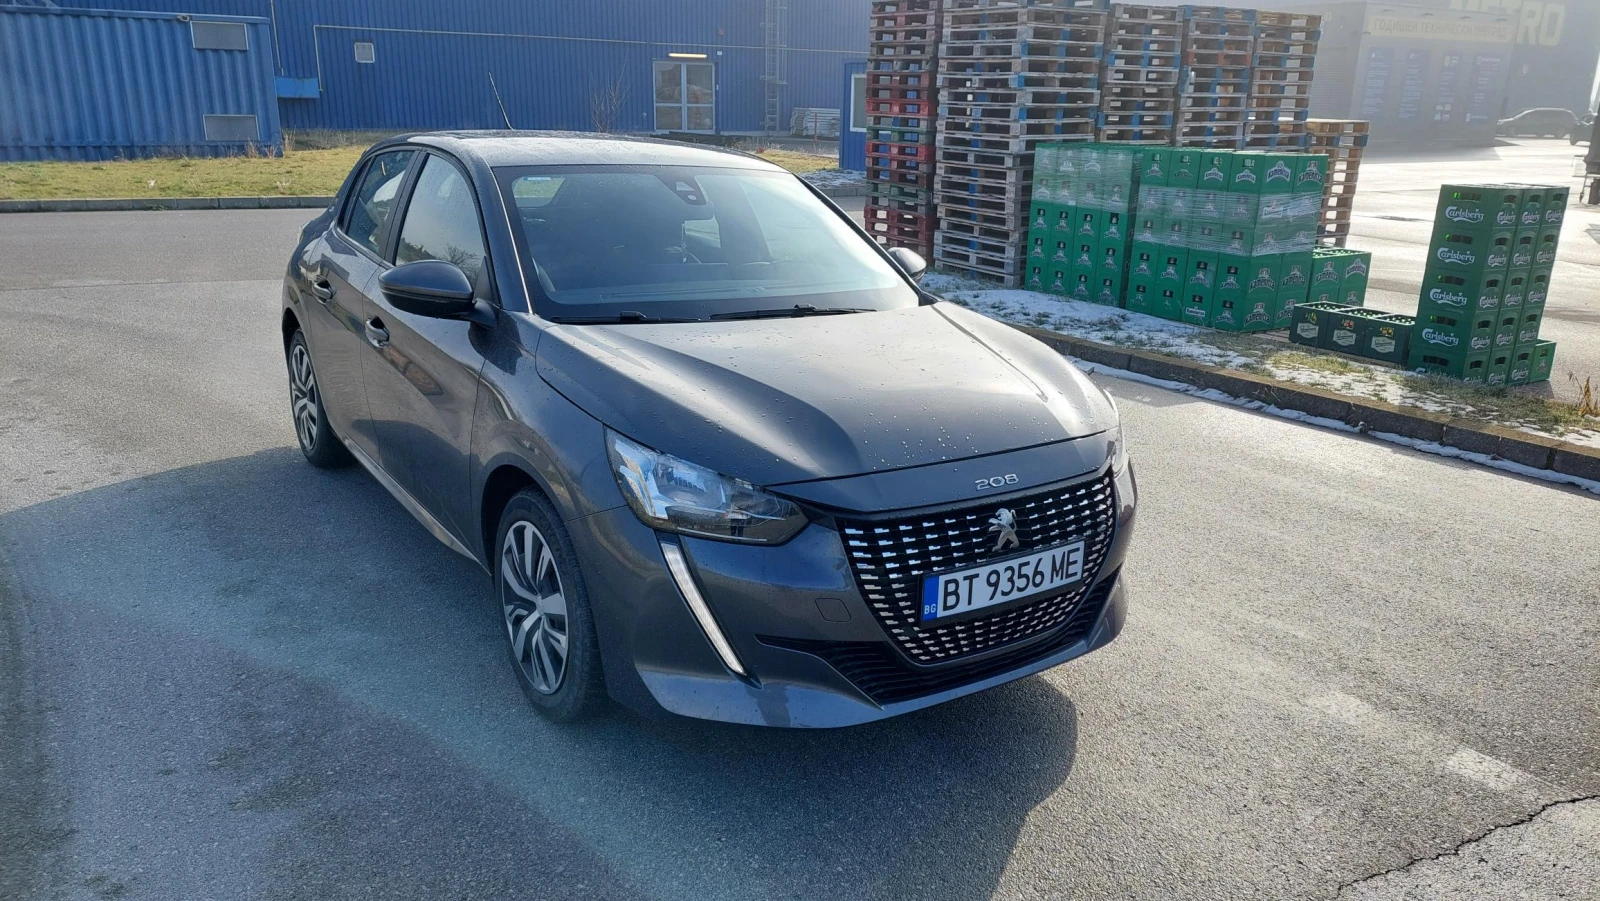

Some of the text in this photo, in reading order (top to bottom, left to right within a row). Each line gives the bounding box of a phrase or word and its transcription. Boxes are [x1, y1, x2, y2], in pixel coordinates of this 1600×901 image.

[1445, 206, 1484, 223] Carlsberg
[1497, 212, 1516, 224] Carlsberg
[1522, 211, 1540, 224] Carlsberg
[1546, 210, 1563, 222] Carlsberg
[1437, 247, 1475, 265] Carlsberg
[1488, 254, 1507, 267] Carlsberg
[1513, 253, 1531, 265] Carlsberg
[1537, 251, 1554, 263] Carlsberg
[1430, 288, 1467, 306] Carlsberg
[1480, 295, 1498, 308] Carlsberg
[1505, 293, 1522, 306] Carlsberg
[1528, 290, 1545, 303] Carlsberg
[1422, 328, 1459, 346] Carlsberg
[1496, 333, 1514, 345] Carlsberg
[1520, 329, 1537, 342] Carlsberg
[1471, 336, 1490, 349] Carlsberg
[1489, 372, 1506, 384] Carlsberg
[1512, 368, 1529, 380] Carlsberg
[975, 474, 1019, 490] 208
[942, 547, 1080, 612] BT 9356 ME
[924, 604, 937, 615] BG
